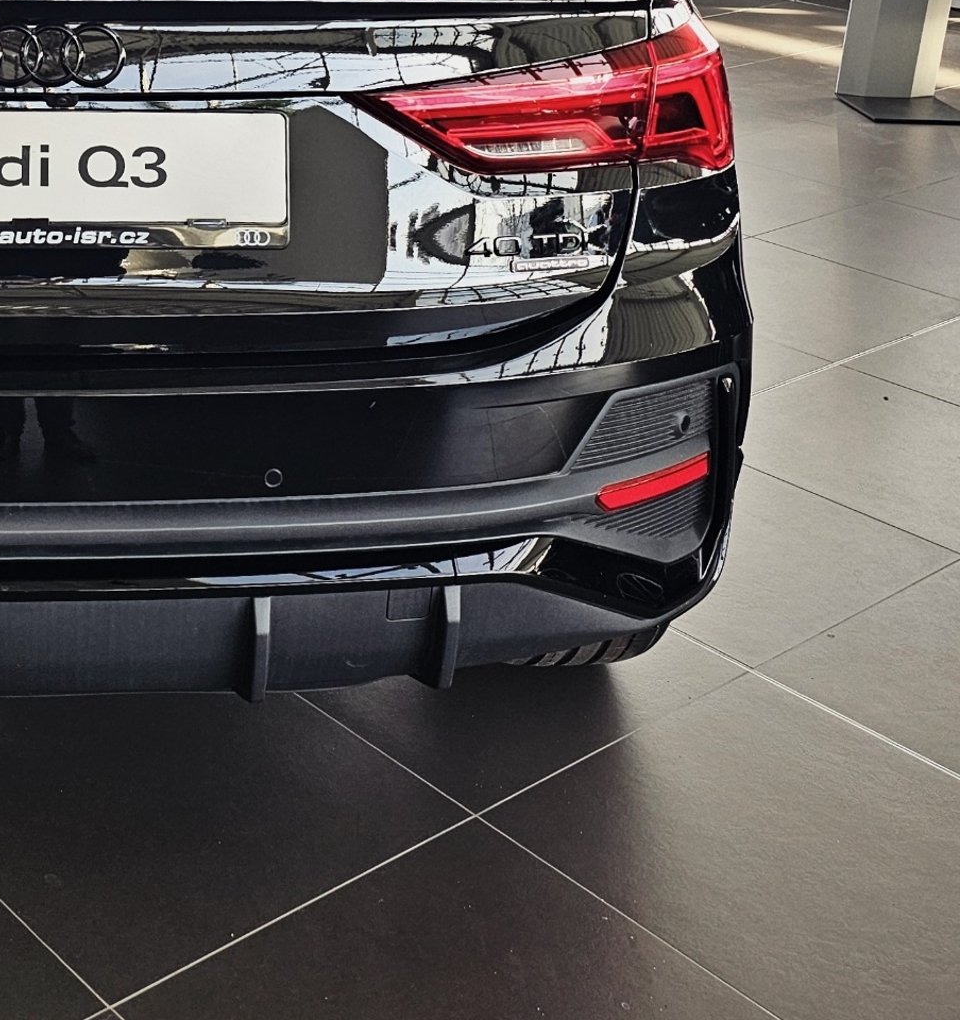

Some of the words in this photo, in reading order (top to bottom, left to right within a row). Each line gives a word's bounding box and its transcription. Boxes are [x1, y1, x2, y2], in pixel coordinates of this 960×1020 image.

[78, 146, 168, 188] Q3
[464, 236, 521, 257] 40
[516, 259, 588, 271] quattro
